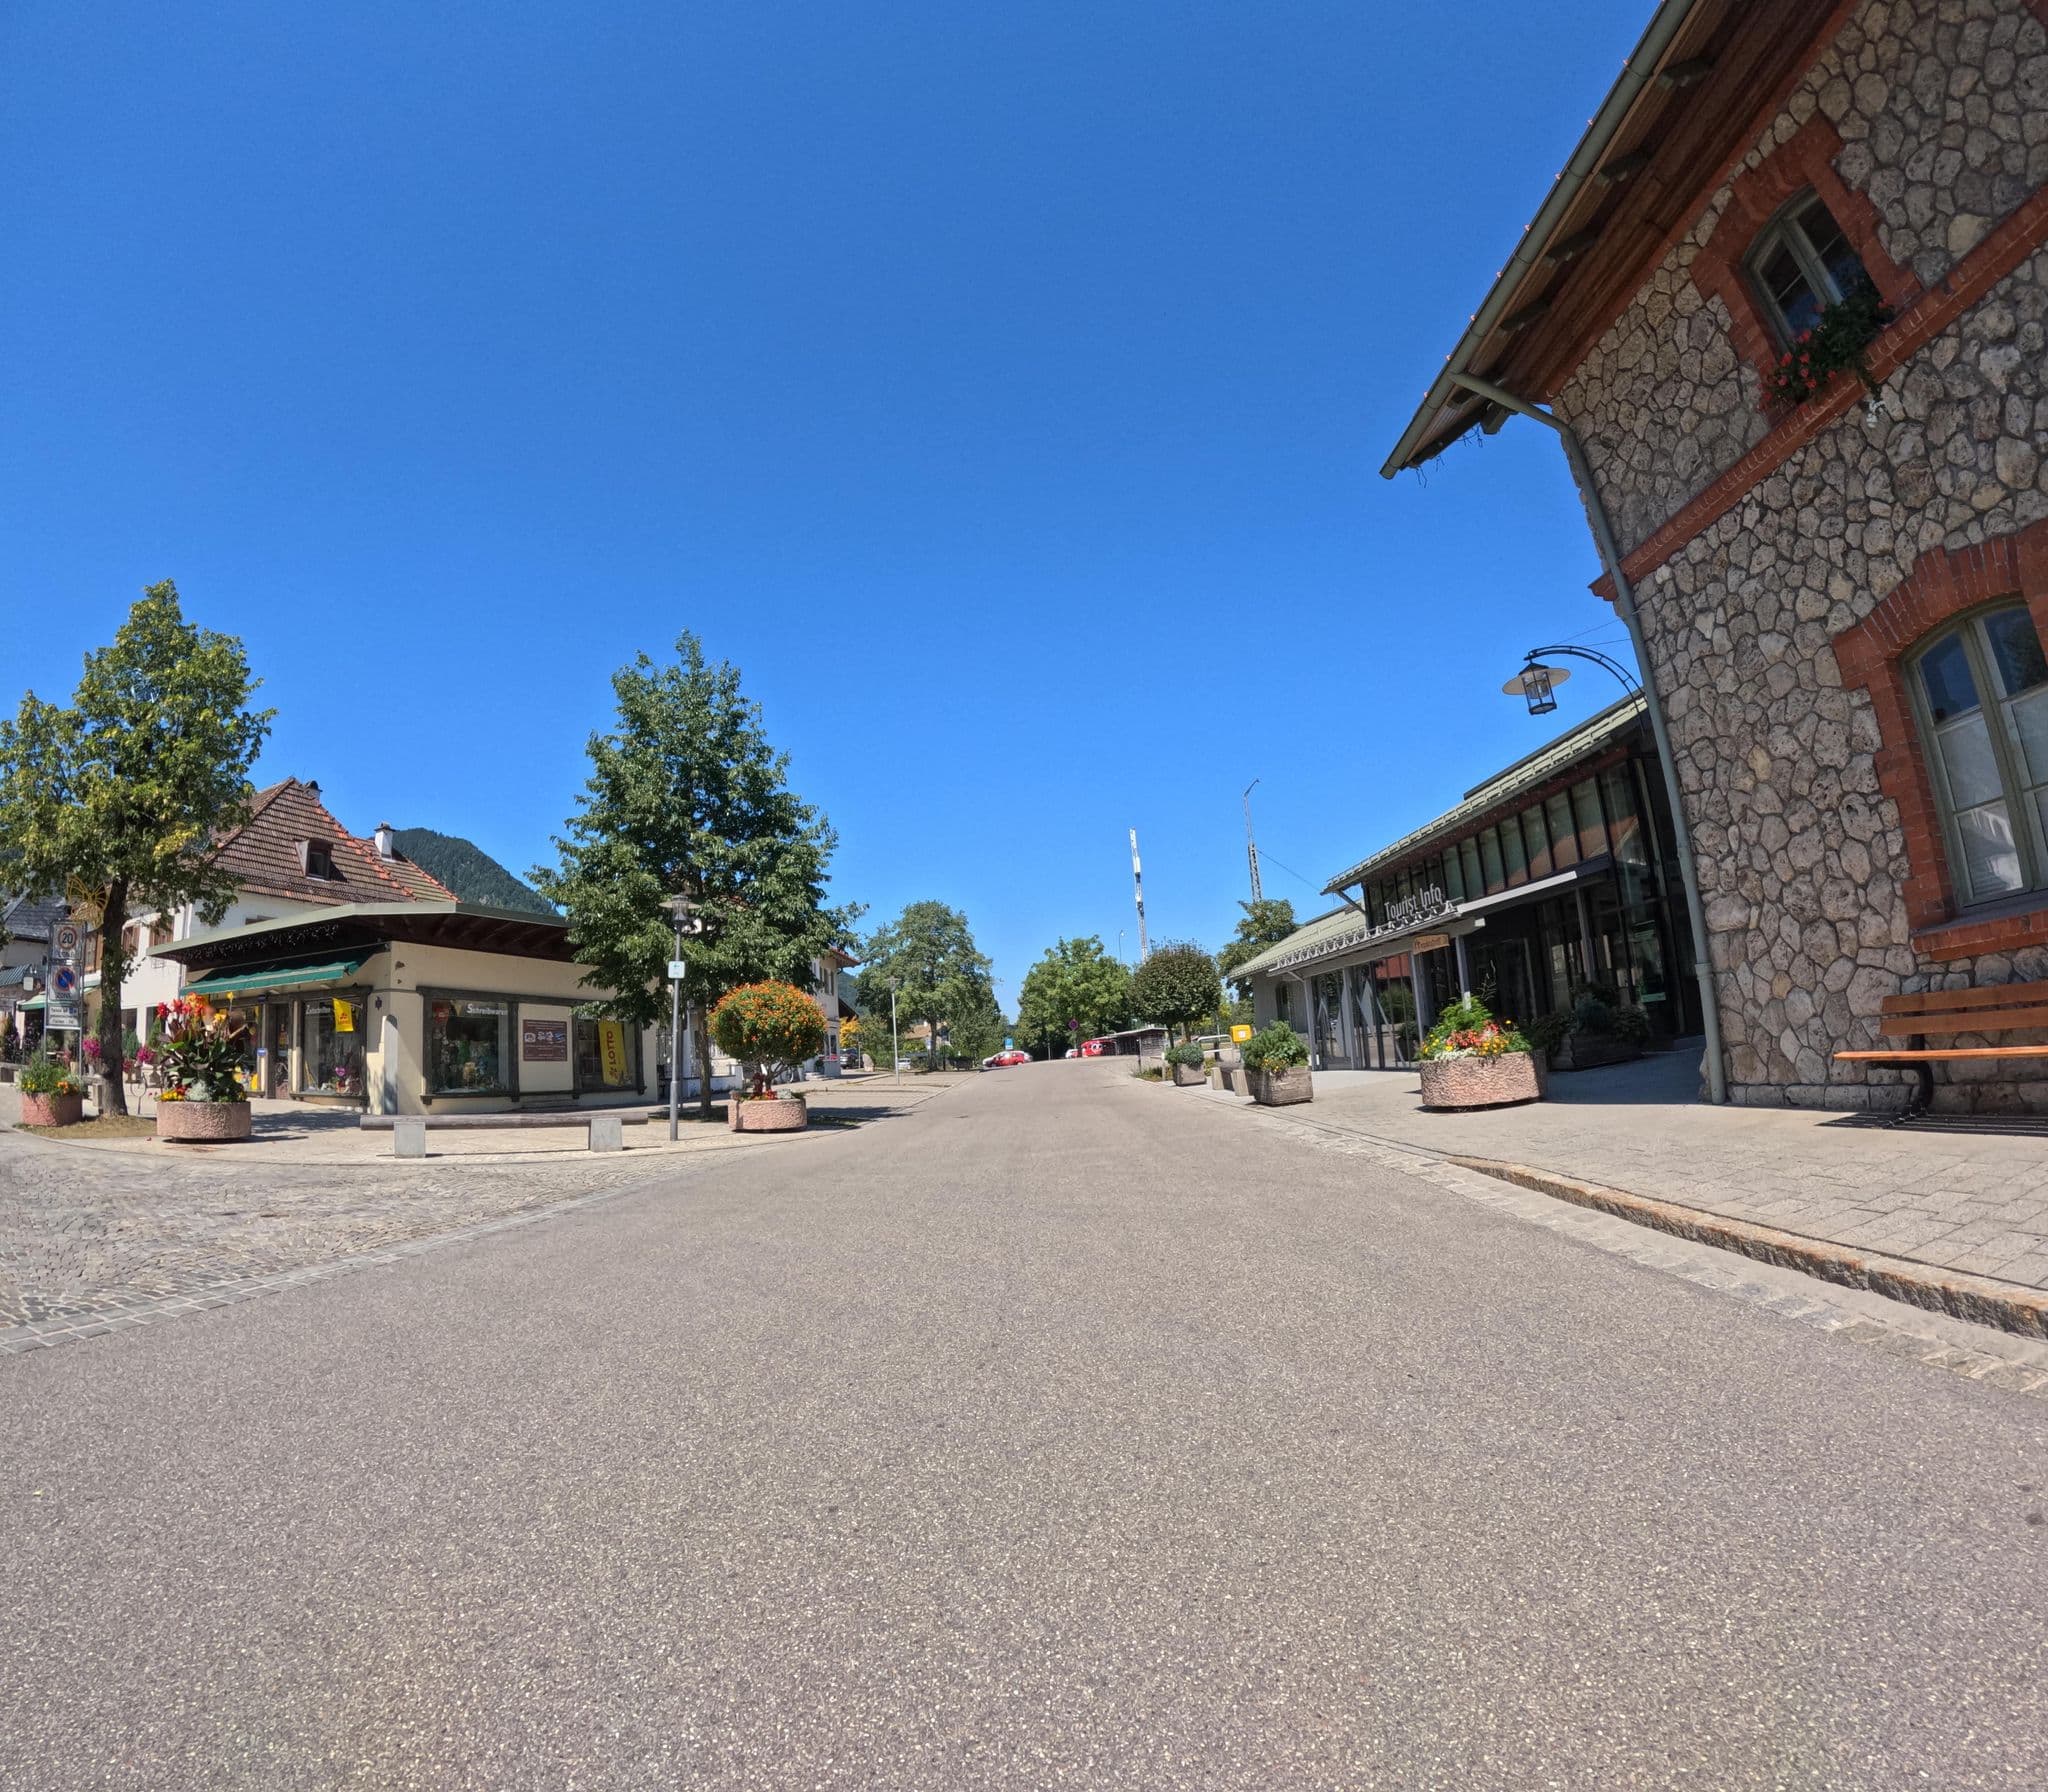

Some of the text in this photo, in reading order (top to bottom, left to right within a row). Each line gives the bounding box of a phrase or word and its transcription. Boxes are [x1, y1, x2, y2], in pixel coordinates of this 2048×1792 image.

[1384, 883, 1442, 920] Tourist Info
[62, 933, 73, 944] 20
[606, 1030, 617, 1065] LOTTO
